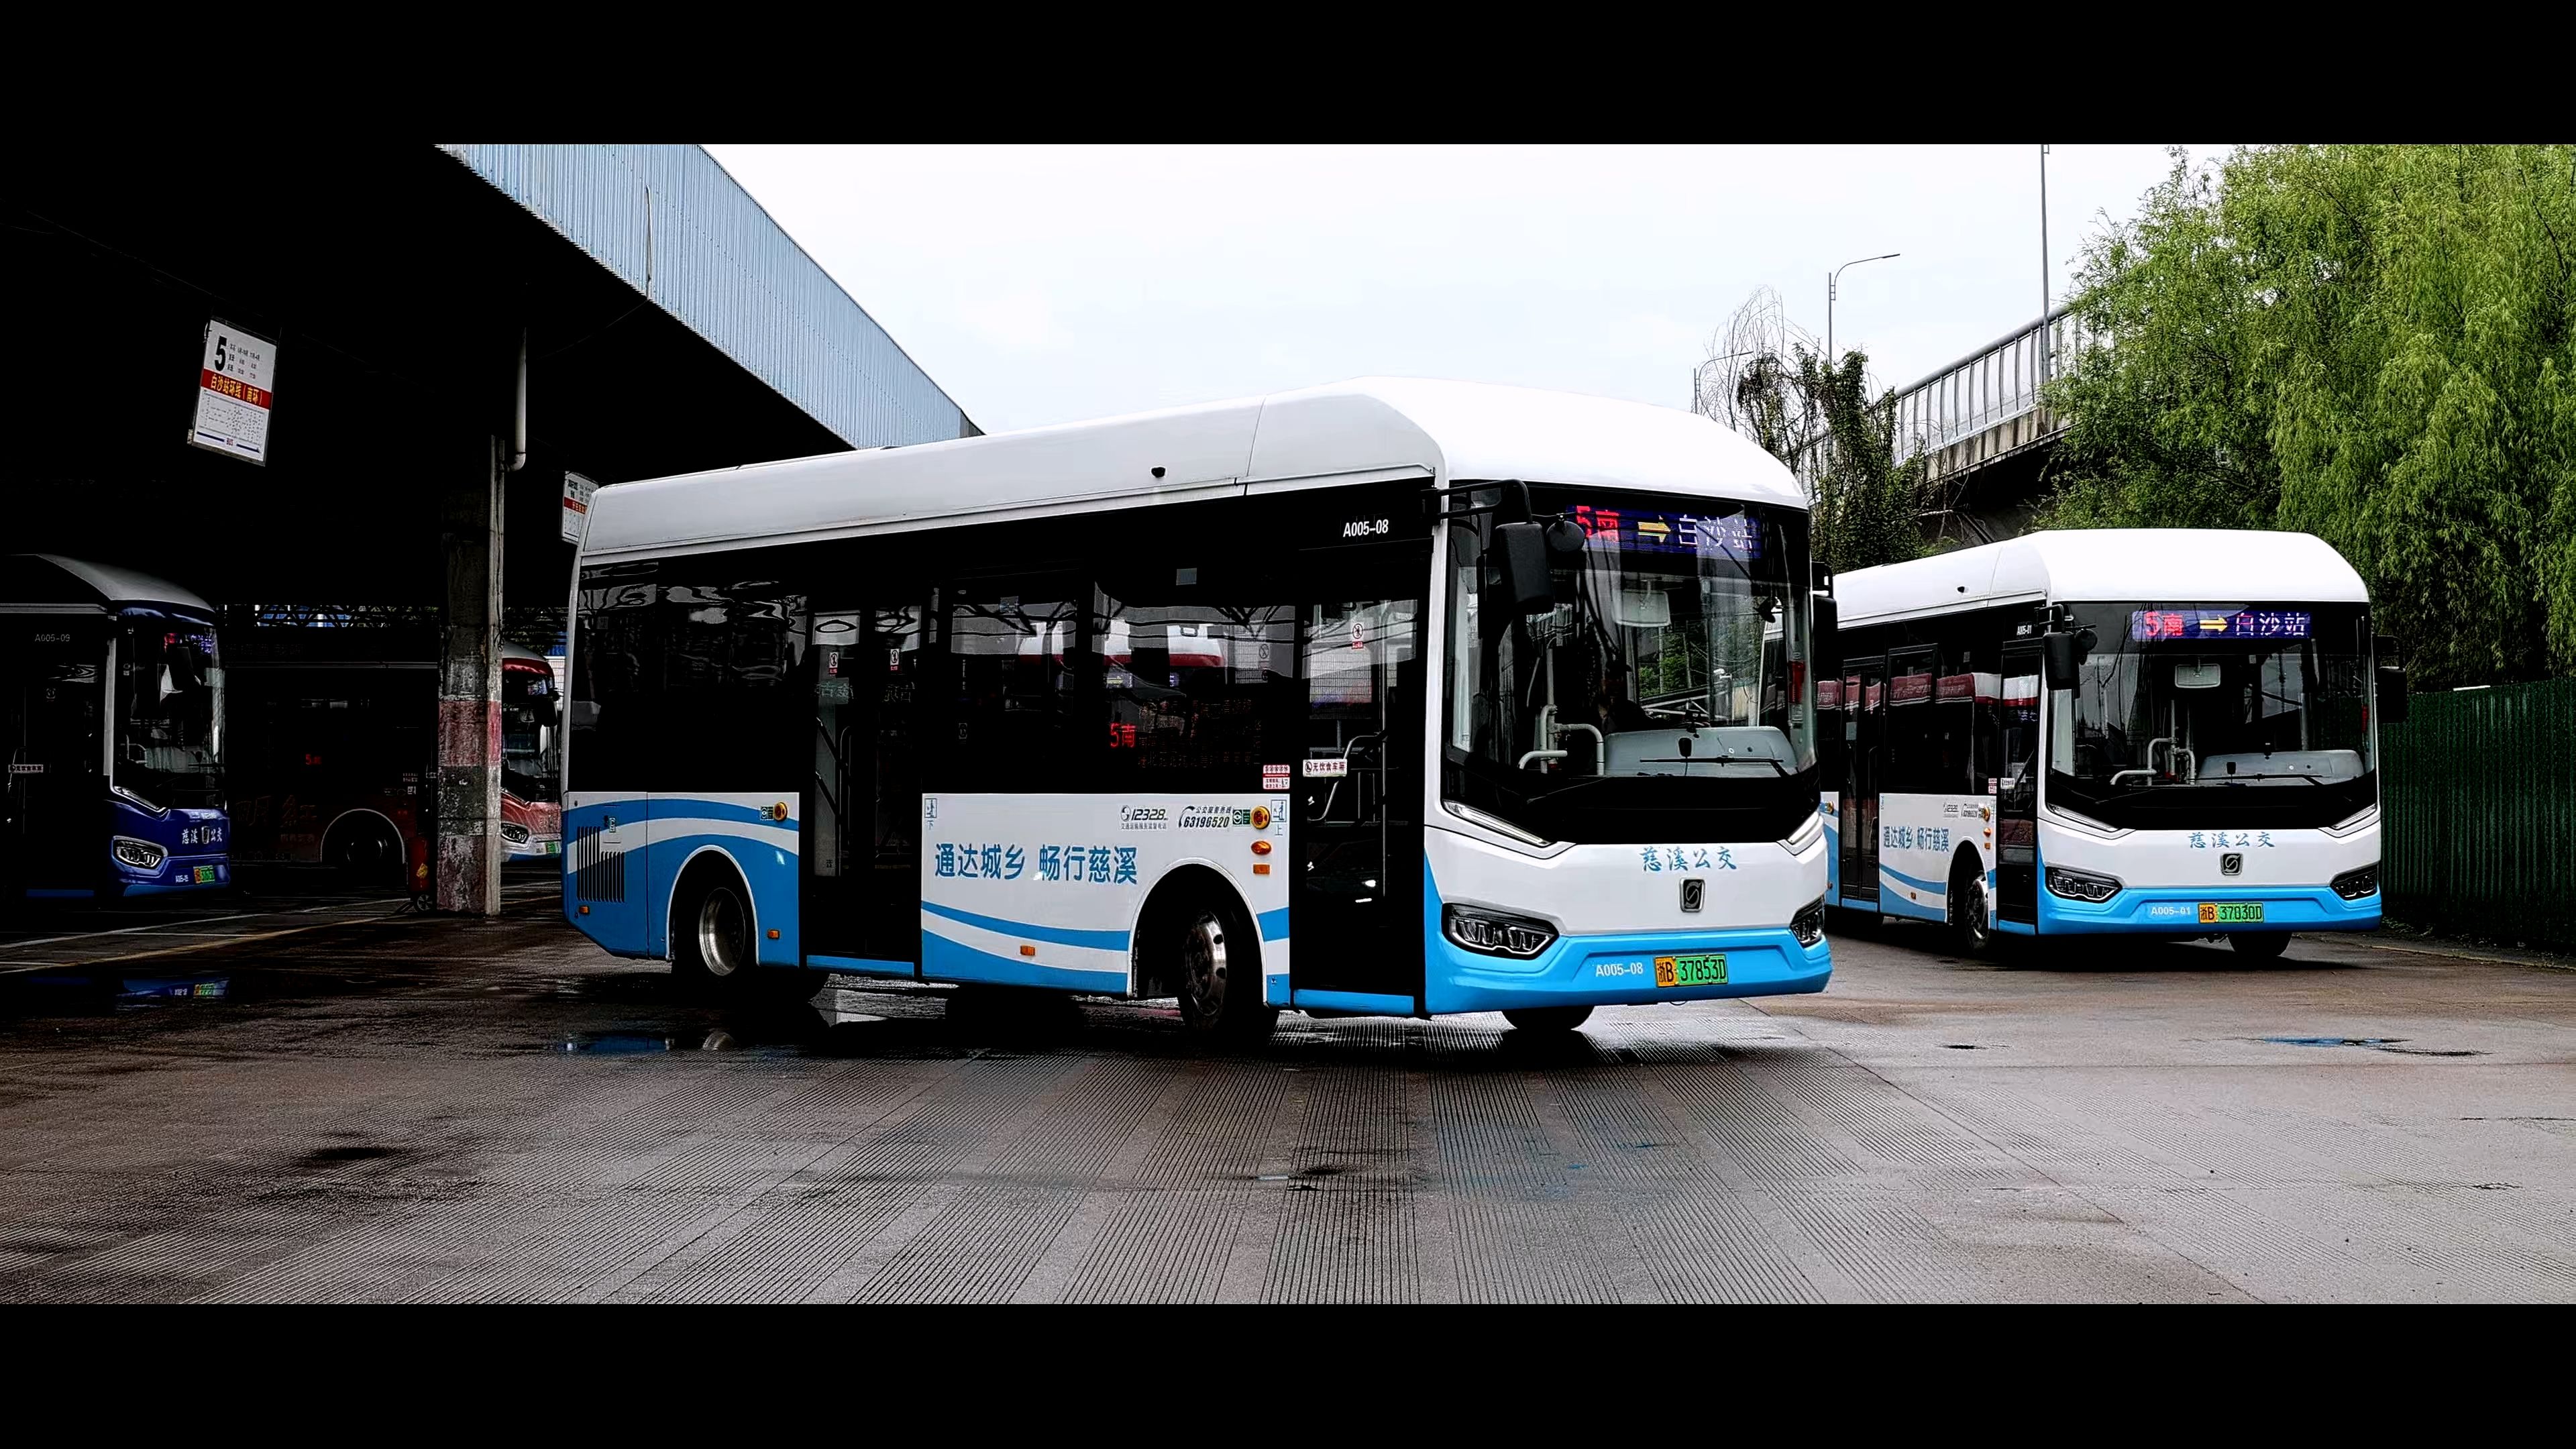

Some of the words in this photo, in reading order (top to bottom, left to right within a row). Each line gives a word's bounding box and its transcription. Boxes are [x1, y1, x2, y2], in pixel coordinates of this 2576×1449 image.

[215, 335, 227, 372] 5
[1343, 519, 1389, 537] A005-08
[2145, 611, 2184, 637] 5南
[2236, 612, 2306, 636] 白沙站
[34, 633, 70, 642] A005-09
[1109, 723, 1136, 749] 5南
[1131, 808, 1166, 820] 12328
[2188, 831, 2276, 849] 慈溪公交
[934, 843, 1026, 880] 通达城乡
[1039, 843, 1138, 885] 畅行慈溪
[1640, 846, 1737, 871] 慈溪公交
[1595, 962, 1644, 977] A005-08
[1680, 957, 1727, 981] 37853D
